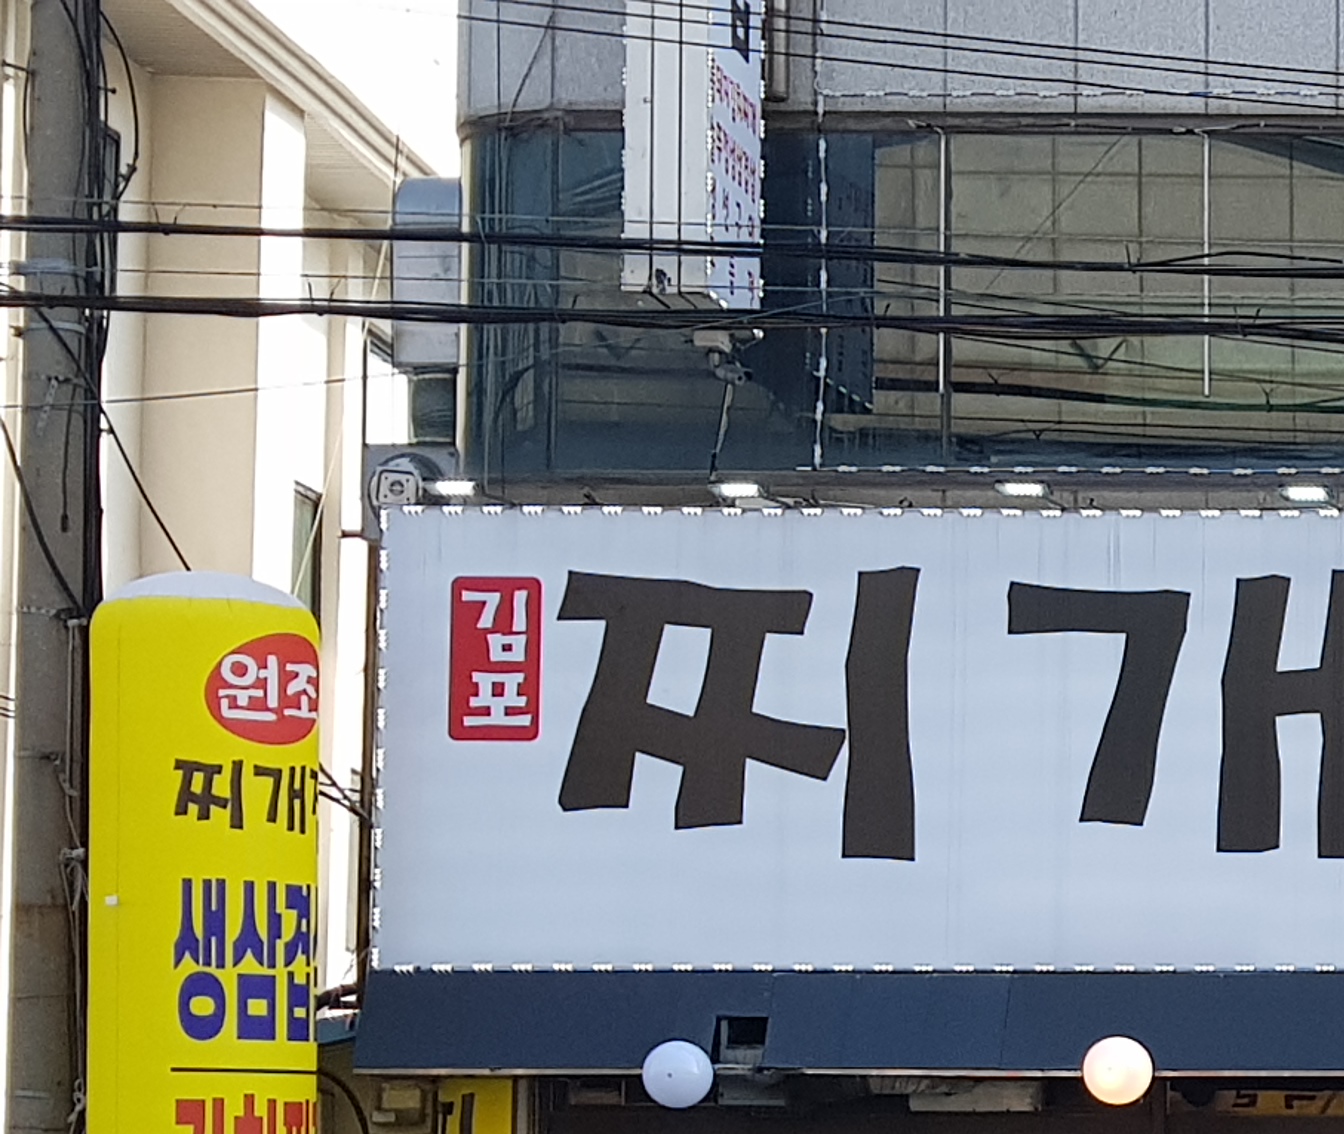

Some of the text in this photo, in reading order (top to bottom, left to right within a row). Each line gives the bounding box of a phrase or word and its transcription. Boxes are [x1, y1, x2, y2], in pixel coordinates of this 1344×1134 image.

[217, 653, 317, 720] 원조
[460, 588, 532, 728] 김포
[173, 758, 318, 835] 찌개
